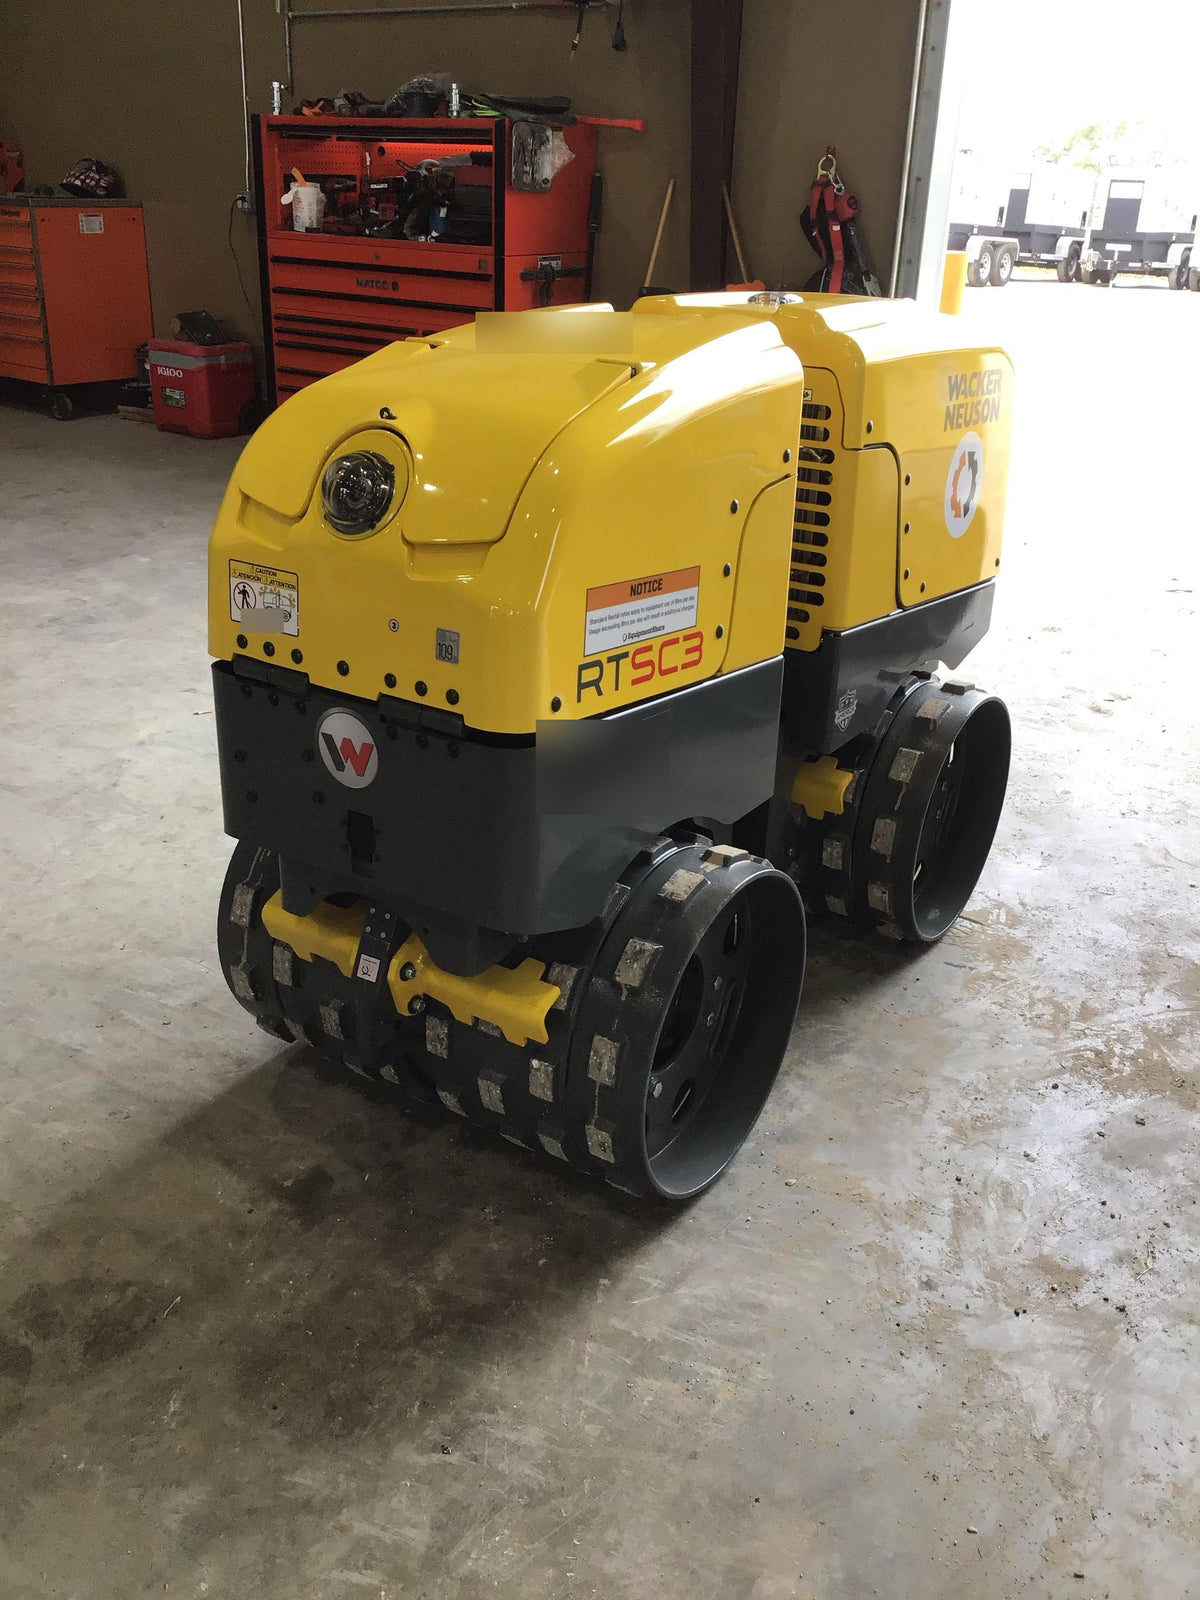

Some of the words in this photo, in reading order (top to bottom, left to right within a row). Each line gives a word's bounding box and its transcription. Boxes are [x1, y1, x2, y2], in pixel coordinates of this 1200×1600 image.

[947, 368, 1003, 402] WACKER
[943, 396, 1001, 432] NEUSON
[255, 567, 277, 577] CAUTION
[269, 579, 296, 590] ATTENTION
[630, 579, 663, 596] NOTICE
[588, 627, 601, 635] Usage
[601, 621, 621, 632] exceeding
[664, 607, 681, 616] additional
[589, 616, 607, 626] Standard
[608, 613, 620, 621] Rental
[645, 602, 664, 612] equipment
[391, 621, 397, 629] 3
[627, 625, 665, 640] EquipmentShare
[438, 642, 453, 661] 109
[577, 631, 704, 703] RTSC3
